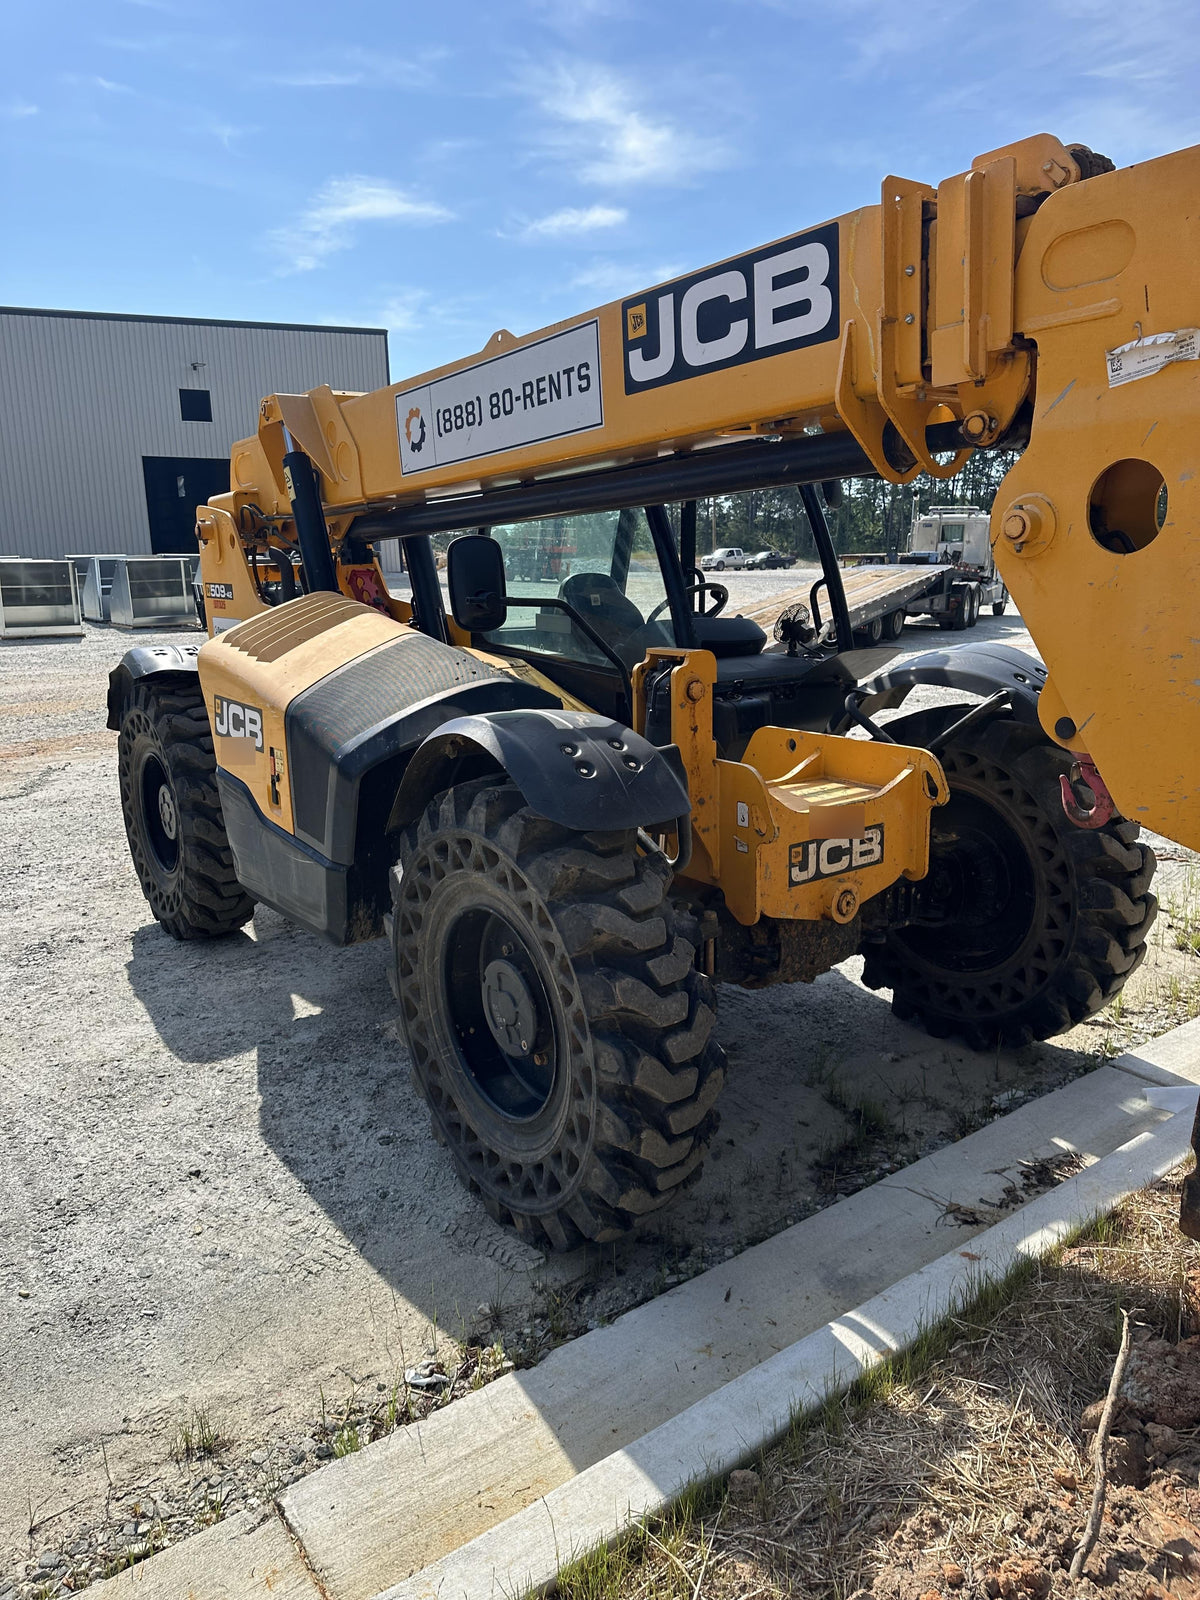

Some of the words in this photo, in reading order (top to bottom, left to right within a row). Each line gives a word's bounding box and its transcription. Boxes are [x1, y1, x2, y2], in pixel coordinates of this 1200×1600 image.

[628, 242, 833, 383] JCB
[436, 395, 483, 438] (888)
[489, 361, 591, 420] 80-RENTS
[216, 700, 263, 748] JCB
[791, 828, 882, 882] JCB
